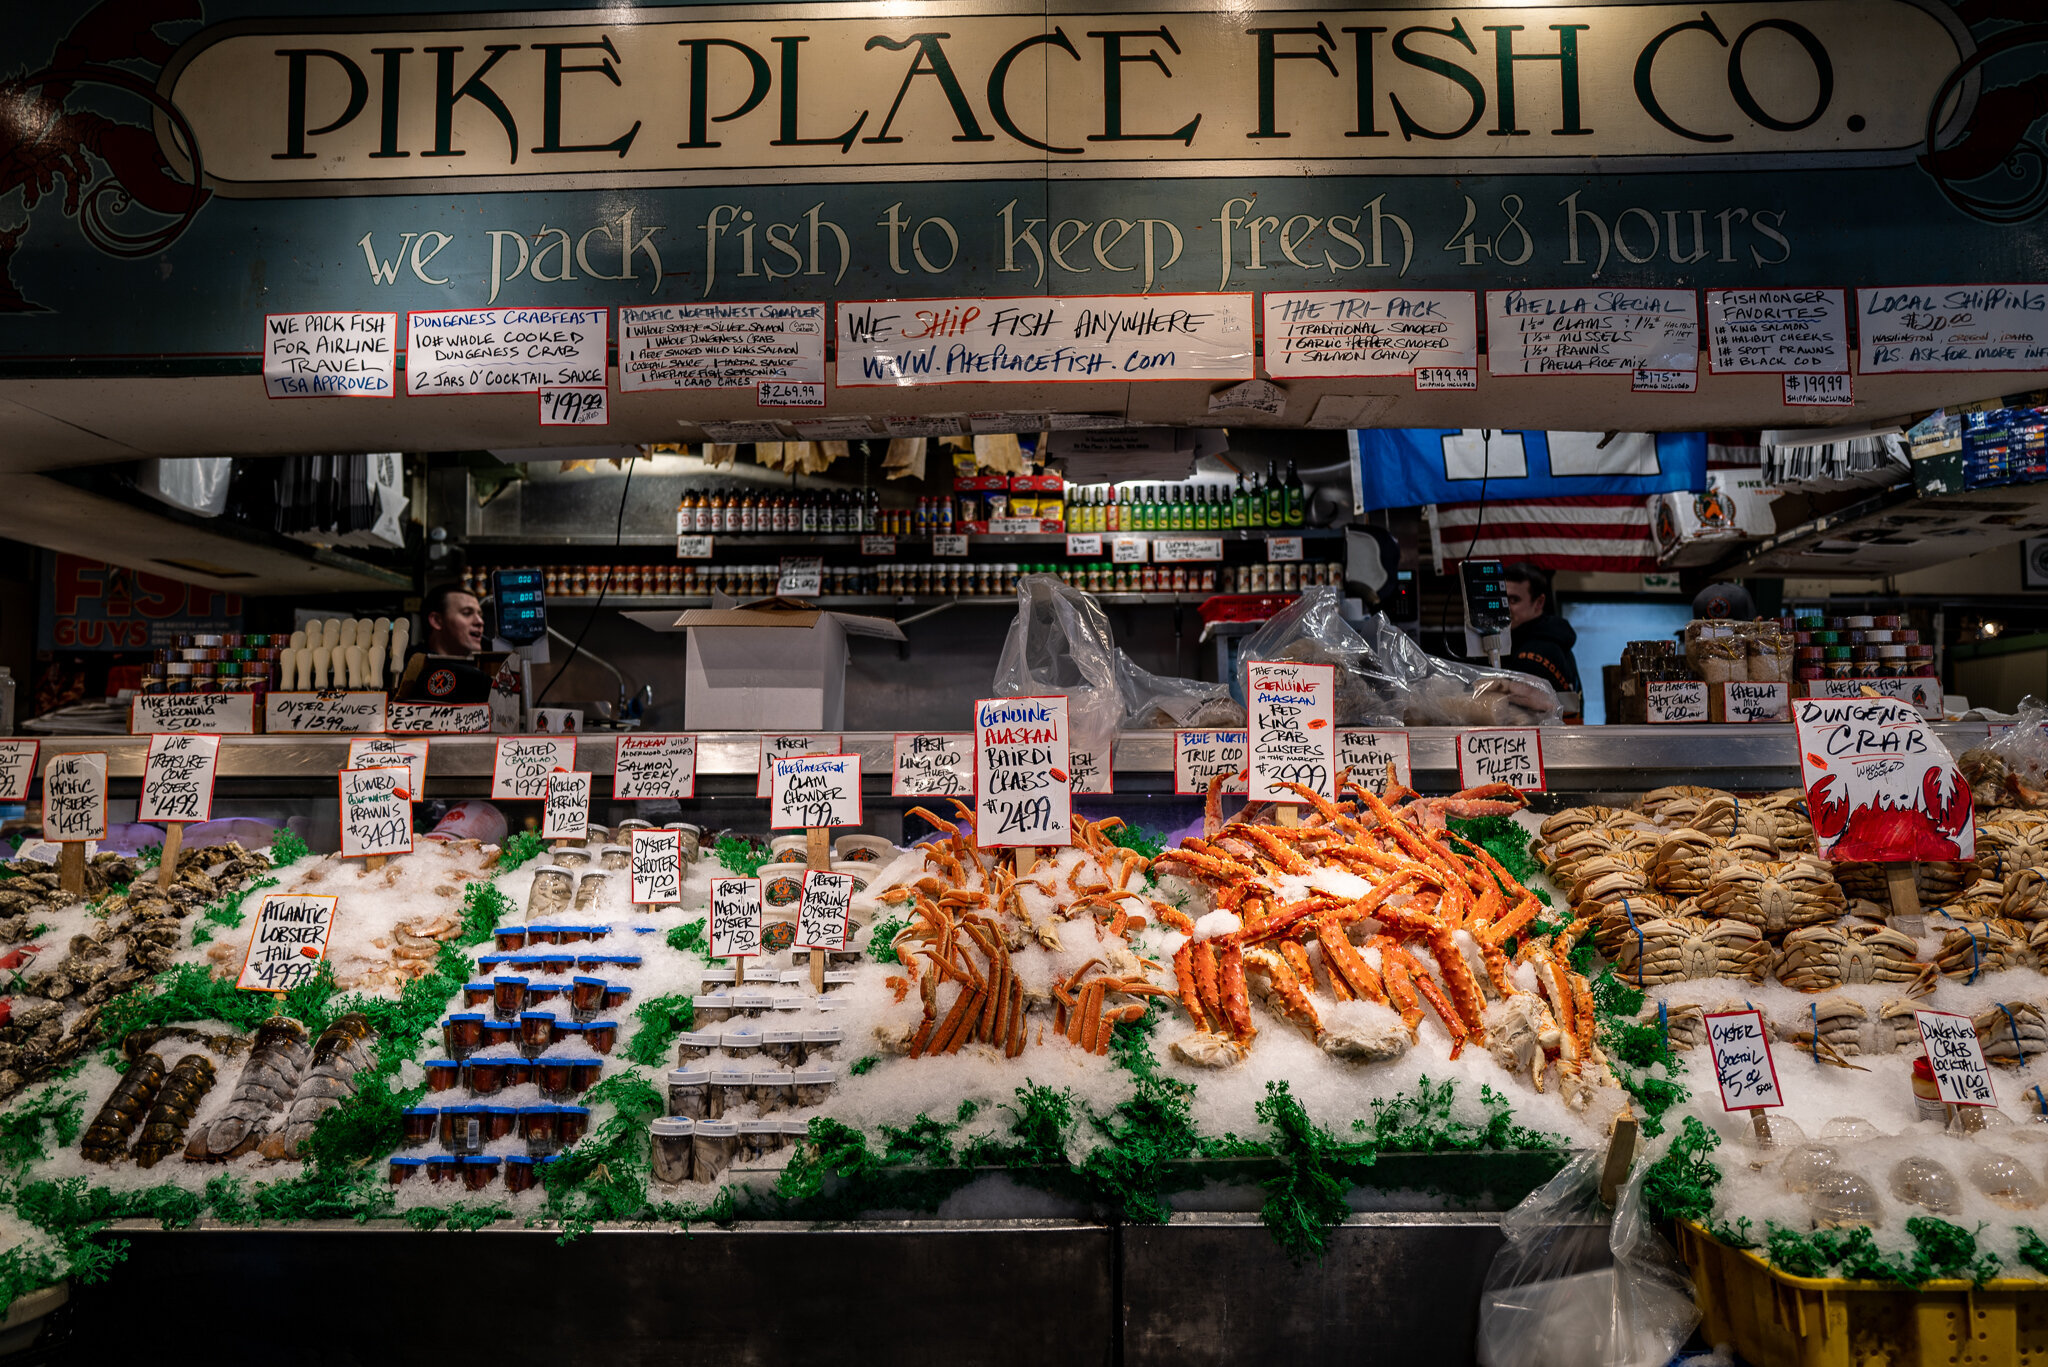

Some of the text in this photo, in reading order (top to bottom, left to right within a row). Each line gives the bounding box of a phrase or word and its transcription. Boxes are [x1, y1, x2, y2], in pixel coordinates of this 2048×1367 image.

[272, 11, 1867, 164] PIKE PLACE FISH CO.
[358, 190, 1793, 305] we pack fish to keep fresh 48 hours
[1504, 291, 1687, 316] PAELLA SPECIAL
[1722, 290, 1835, 305] FISHMONGER
[1867, 288, 2046, 315] LOCAL SHIPPING
[678, 304, 760, 319] NORTHWEST
[1270, 299, 1328, 322] THE
[1723, 306, 1828, 320] FAVORITES
[269, 315, 386, 335] WE PACK FISH
[413, 310, 609, 329] DUNGENESS CRABFEAST
[847, 306, 903, 344] WE
[901, 306, 980, 339] SHIP
[986, 308, 1063, 337] FISH
[1073, 308, 1215, 339] ANYWHERE
[1552, 316, 1614, 332] CLAMS
[1730, 322, 1809, 333] KING SALMON
[634, 322, 785, 336] WHOLE SALMON
[1296, 321, 1449, 335] TRADITIONAL SMOKED
[446, 331, 585, 347] WHOLE COOKED
[656, 336, 687, 348] WHOLE
[746, 334, 776, 344] CRAB
[1296, 337, 1450, 349] GARLIC SMOKED
[1558, 331, 1633, 343] MUSSELS
[1731, 332, 1835, 344] HALIBUT CHEEKS
[274, 337, 390, 355] FOR AIRLINE
[435, 345, 580, 361] DUNGENESS CRAB
[664, 343, 799, 358] SMOKED SALMON
[1555, 343, 1611, 357] PRAWNS
[1737, 344, 1835, 356] SPOT PRAWNS
[1301, 350, 1421, 364] SALMON CANDY
[1739, 356, 1822, 366] BLACK COD
[1909, 347, 2017, 362] ASK MORE
[281, 357, 384, 374] TRAVEL
[1540, 357, 1616, 371] PAELLA RICE
[416, 369, 603, 389] 2 JARS SAUCE
[684, 378, 712, 387] CRAB
[1418, 369, 1469, 382] $199.99
[275, 376, 389, 393] TSA APPROVED
[760, 385, 815, 398] $269.99
[1818, 394, 1852, 403] INCLUDED
[1737, 480, 1762, 489] PIKE
[53, 618, 148, 647] GUYS
[1250, 667, 1299, 679] THE ONLY
[1254, 677, 1321, 693] GENUINE
[1730, 682, 1779, 701] PAELLA
[1257, 692, 1316, 706] ALASKAN
[277, 701, 378, 717] OYSTER KNIVES
[387, 706, 428, 718] BEST
[980, 702, 1058, 728] GENUINE
[1269, 703, 1302, 717] RED
[392, 719, 434, 731] EVER
[1258, 713, 1299, 730] KING
[984, 719, 1058, 747] ALASKAN
[1181, 732, 1211, 746] BLUE
[1260, 729, 1309, 744] CRAB
[1827, 724, 1928, 755] CRAB
[163, 736, 196, 751] LIVE
[502, 741, 558, 757] SALTED
[622, 736, 667, 749] ALASKAN
[1254, 743, 1325, 756] CLUSTERS
[1468, 736, 1527, 755] CATFISH
[149, 754, 213, 770] TREASURE
[934, 751, 961, 767] COD
[987, 745, 1053, 770] BAIRDI
[1182, 747, 1243, 763] TRUE COD
[56, 758, 82, 777] LIVE
[515, 762, 547, 779] COD
[617, 758, 673, 773] SALMON
[1188, 763, 1240, 777] FILLETS
[1476, 754, 1531, 775] FILLETS
[1856, 758, 1888, 779] WHOLE
[161, 768, 193, 782] COVE
[631, 768, 680, 781] JERKY
[789, 773, 828, 791] CLAM
[989, 770, 1050, 795] CRABS
[50, 775, 95, 797] PACIFIC
[146, 781, 200, 796] OYSTERS
[346, 774, 396, 795] JUMBO
[620, 781, 671, 798] $49.99
[51, 794, 99, 812] OYSTERS
[546, 792, 588, 810] HERRING
[783, 785, 847, 805] CHOWDER
[150, 794, 199, 817] $14.99
[350, 803, 401, 823] PRAWNS
[982, 795, 1052, 834] $24.99
[347, 817, 407, 850] $34.99
[635, 836, 679, 855] OYSTER
[632, 856, 681, 875] SHOOTER
[716, 881, 756, 896] FRESH
[804, 885, 850, 908] YEARLING
[262, 900, 328, 925] ATLANTIC
[714, 900, 762, 917] MEDIUM
[802, 904, 846, 920] OYSTER
[714, 916, 755, 931] OYSTER
[260, 925, 326, 944] LOBSTER
[256, 944, 301, 962] TAIL
[1712, 1022, 1763, 1044] OYSTER
[1920, 1017, 1978, 1041] DUNGENESS
[1934, 1038, 1972, 1058] CRAB
[1932, 1056, 1988, 1073] COCKTAIL
